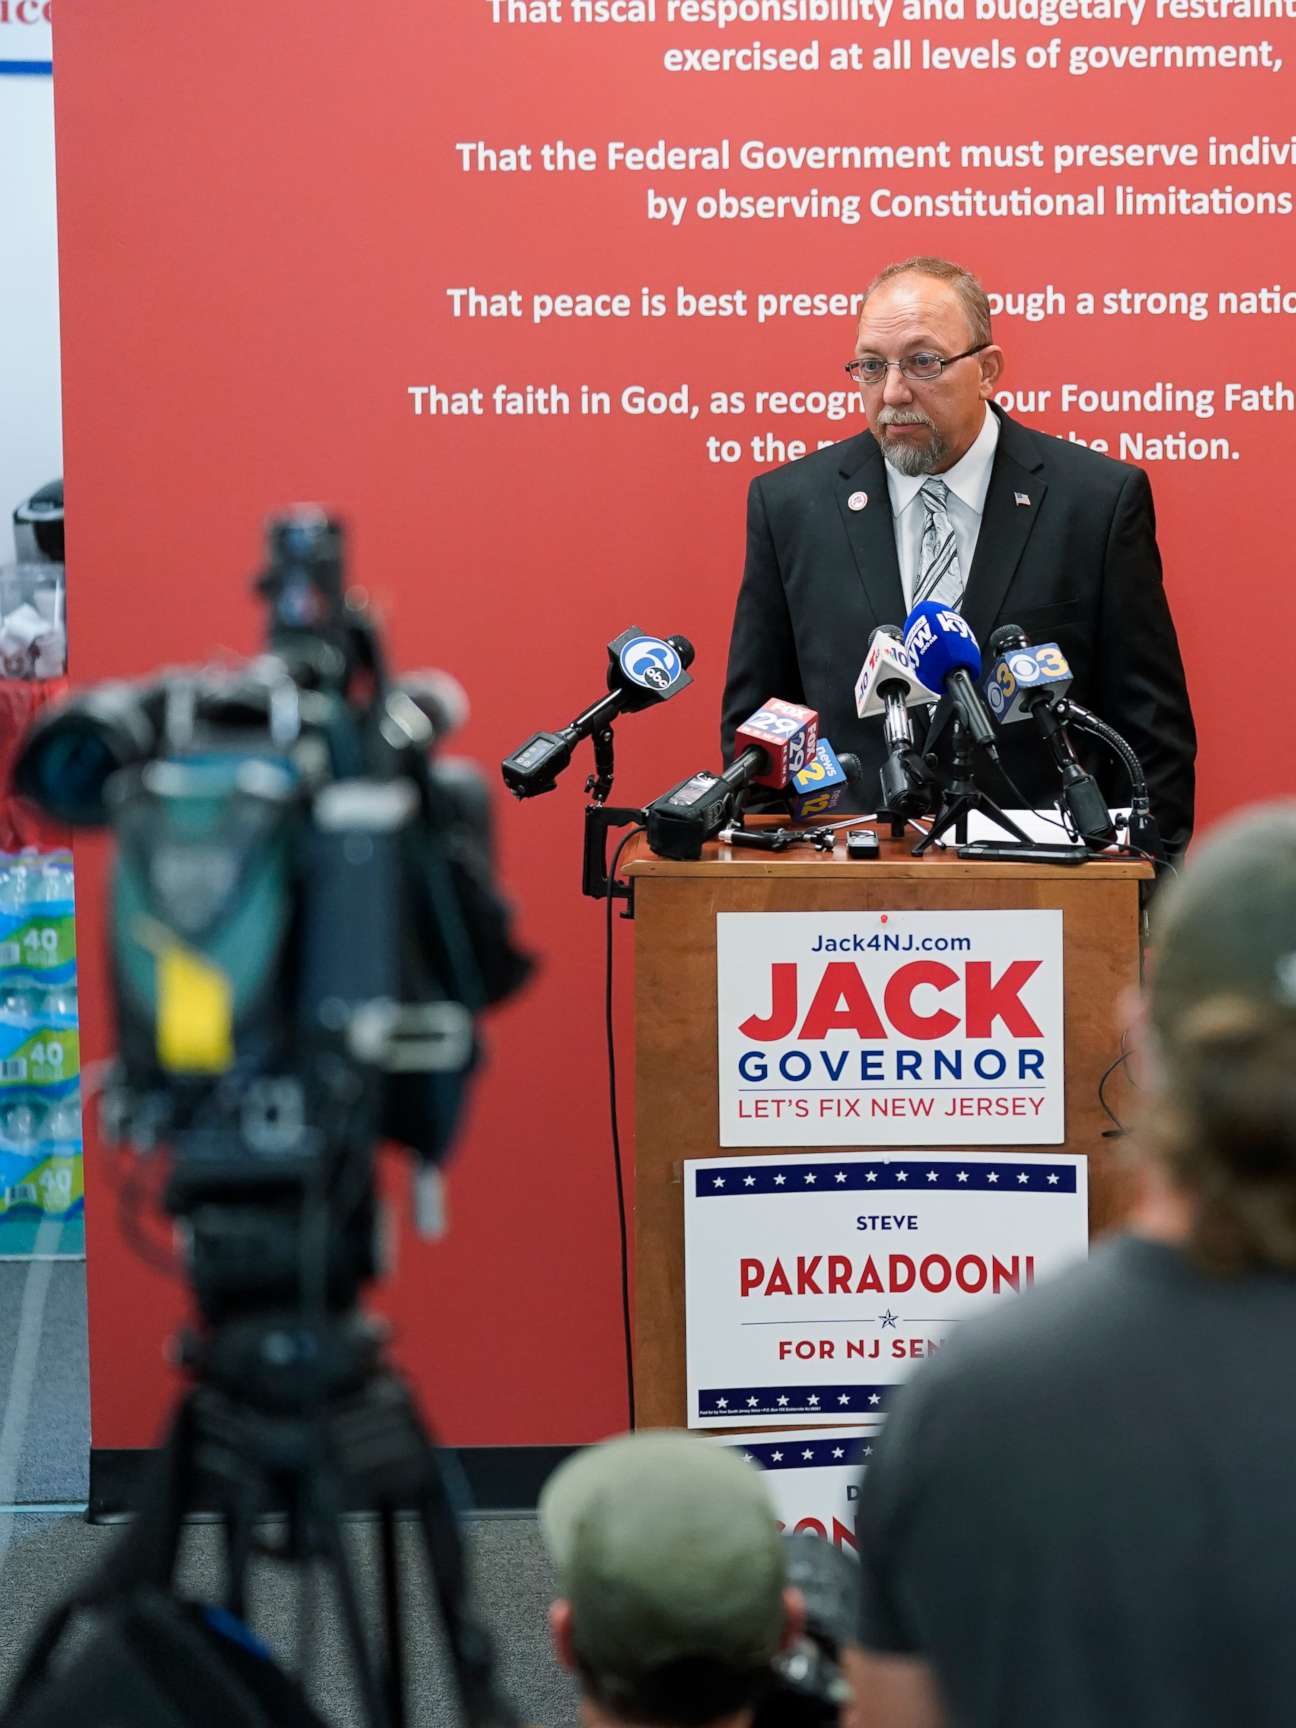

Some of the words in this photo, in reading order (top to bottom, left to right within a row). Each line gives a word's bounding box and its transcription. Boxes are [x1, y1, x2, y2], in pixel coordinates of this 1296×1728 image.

[488, 0, 562, 23] That
[570, 0, 656, 23] fiscal
[667, 0, 894, 29] responsibility
[902, 0, 965, 21] and
[975, 0, 1146, 26] budgetary
[663, 39, 819, 72] exercised
[829, 43, 863, 71] at
[872, 39, 911, 70] all
[922, 38, 1017, 70] levels
[1026, 38, 1062, 69] of
[1069, 40, 1282, 75] government,
[455, 141, 532, 172] That
[540, 140, 597, 171] the
[608, 139, 730, 171] Federal
[740, 140, 951, 170] Government
[960, 140, 1044, 168] must
[1054, 143, 1198, 174] preserve
[647, 188, 688, 226] by
[696, 188, 861, 225] observing
[870, 185, 1105, 218] Constitutional
[1116, 185, 1293, 215] limitations
[446, 286, 523, 317] That
[533, 294, 631, 324] peace
[641, 287, 667, 317] is
[677, 286, 748, 317] best
[1076, 292, 1095, 315] a
[1103, 288, 1209, 321] strong
[407, 384, 484, 415] That
[492, 384, 570, 415] faith
[581, 384, 611, 415] in
[621, 384, 699, 420] God,
[710, 391, 746, 414] as
[996, 390, 1052, 411] our
[1061, 382, 1215, 419] Founding
[706, 436, 742, 463] to
[750, 432, 807, 463] the
[1119, 431, 1240, 461] Nation.
[1035, 647, 1070, 678] 3
[996, 662, 1016, 698] 3
[748, 711, 799, 737] 29
[788, 731, 806, 772] 29
[815, 746, 837, 777] news
[23, 927, 58, 951] 40
[811, 933, 972, 953] Jack4NJ.com
[738, 960, 1044, 1042] JACK
[30, 1041, 64, 1066] 40
[738, 1048, 1046, 1083] GOVERNOR
[738, 1099, 810, 1119] LET'S
[819, 1098, 861, 1118] FIX
[870, 1098, 934, 1117] NEW
[944, 1097, 1046, 1117] JERSEY
[856, 1214, 920, 1232] STEVE
[739, 1253, 1036, 1298] PAKRADOONI
[778, 1341, 836, 1361] FOR
[846, 1339, 881, 1360] NJ
